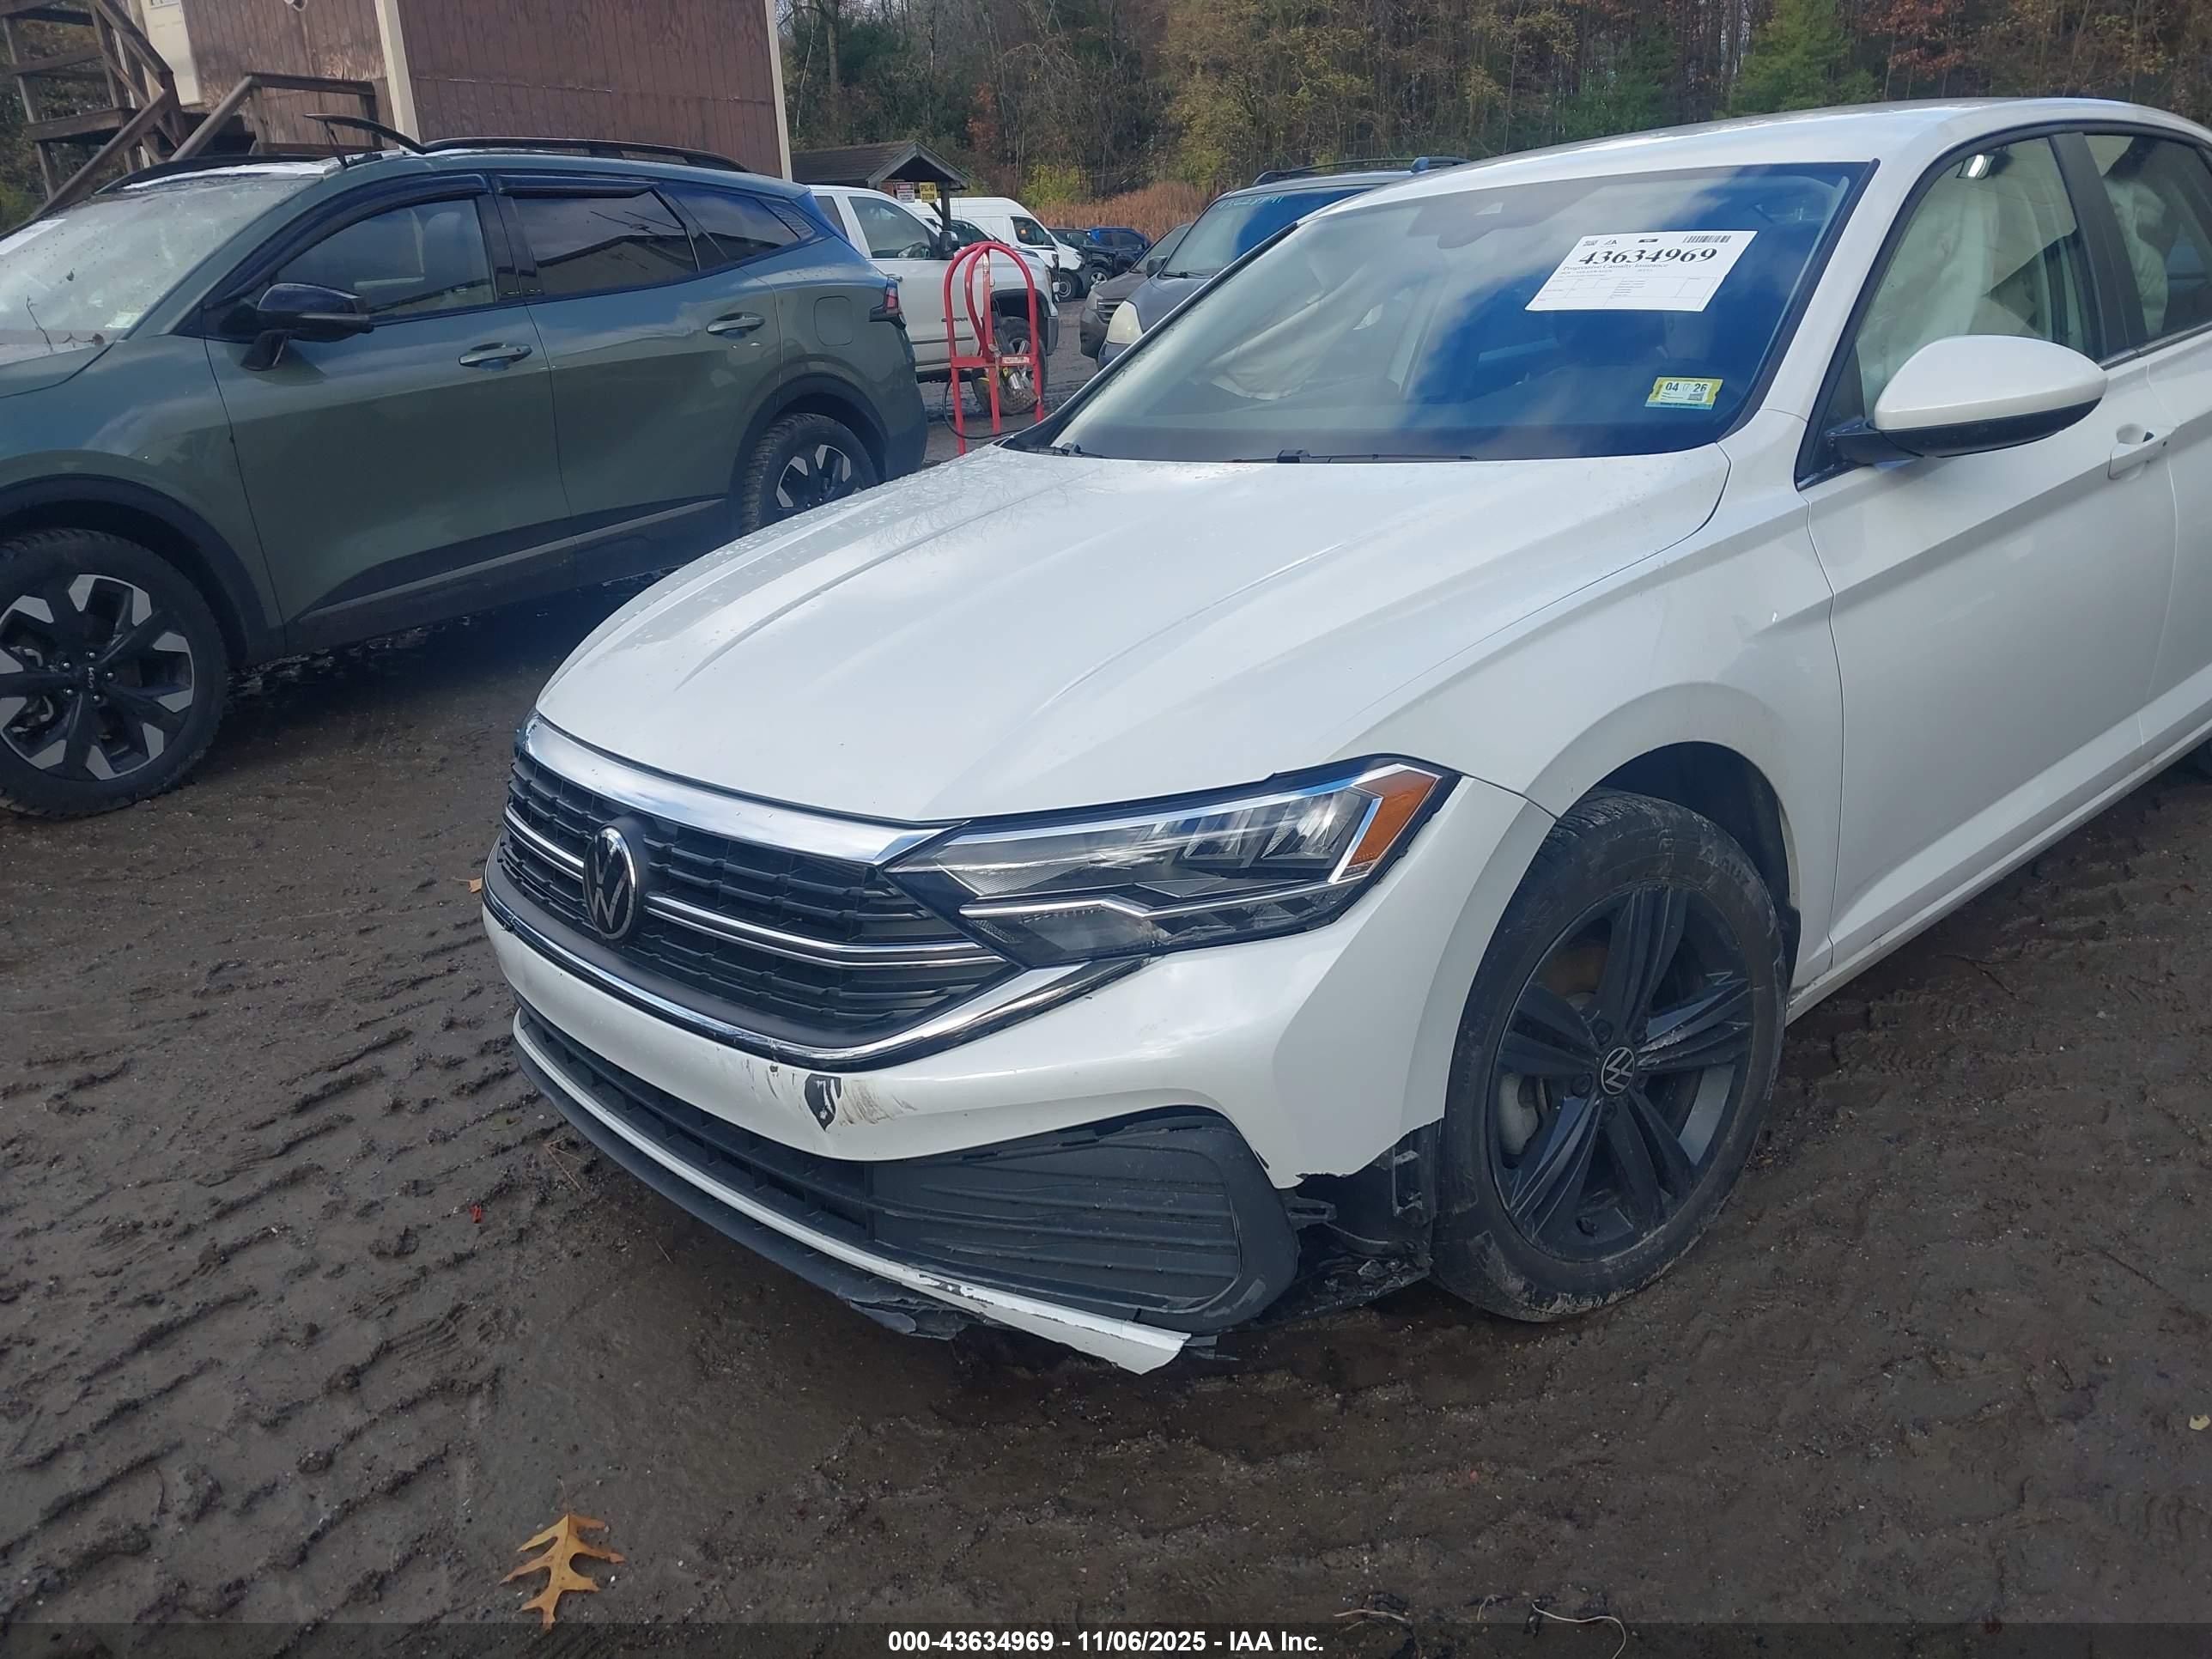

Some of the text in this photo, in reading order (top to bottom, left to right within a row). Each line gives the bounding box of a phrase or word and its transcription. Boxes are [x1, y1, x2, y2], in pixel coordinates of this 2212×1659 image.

[1579, 248, 1717, 264] 43634969
[1666, 383, 1679, 392] 04
[1693, 384, 1708, 392] 26
